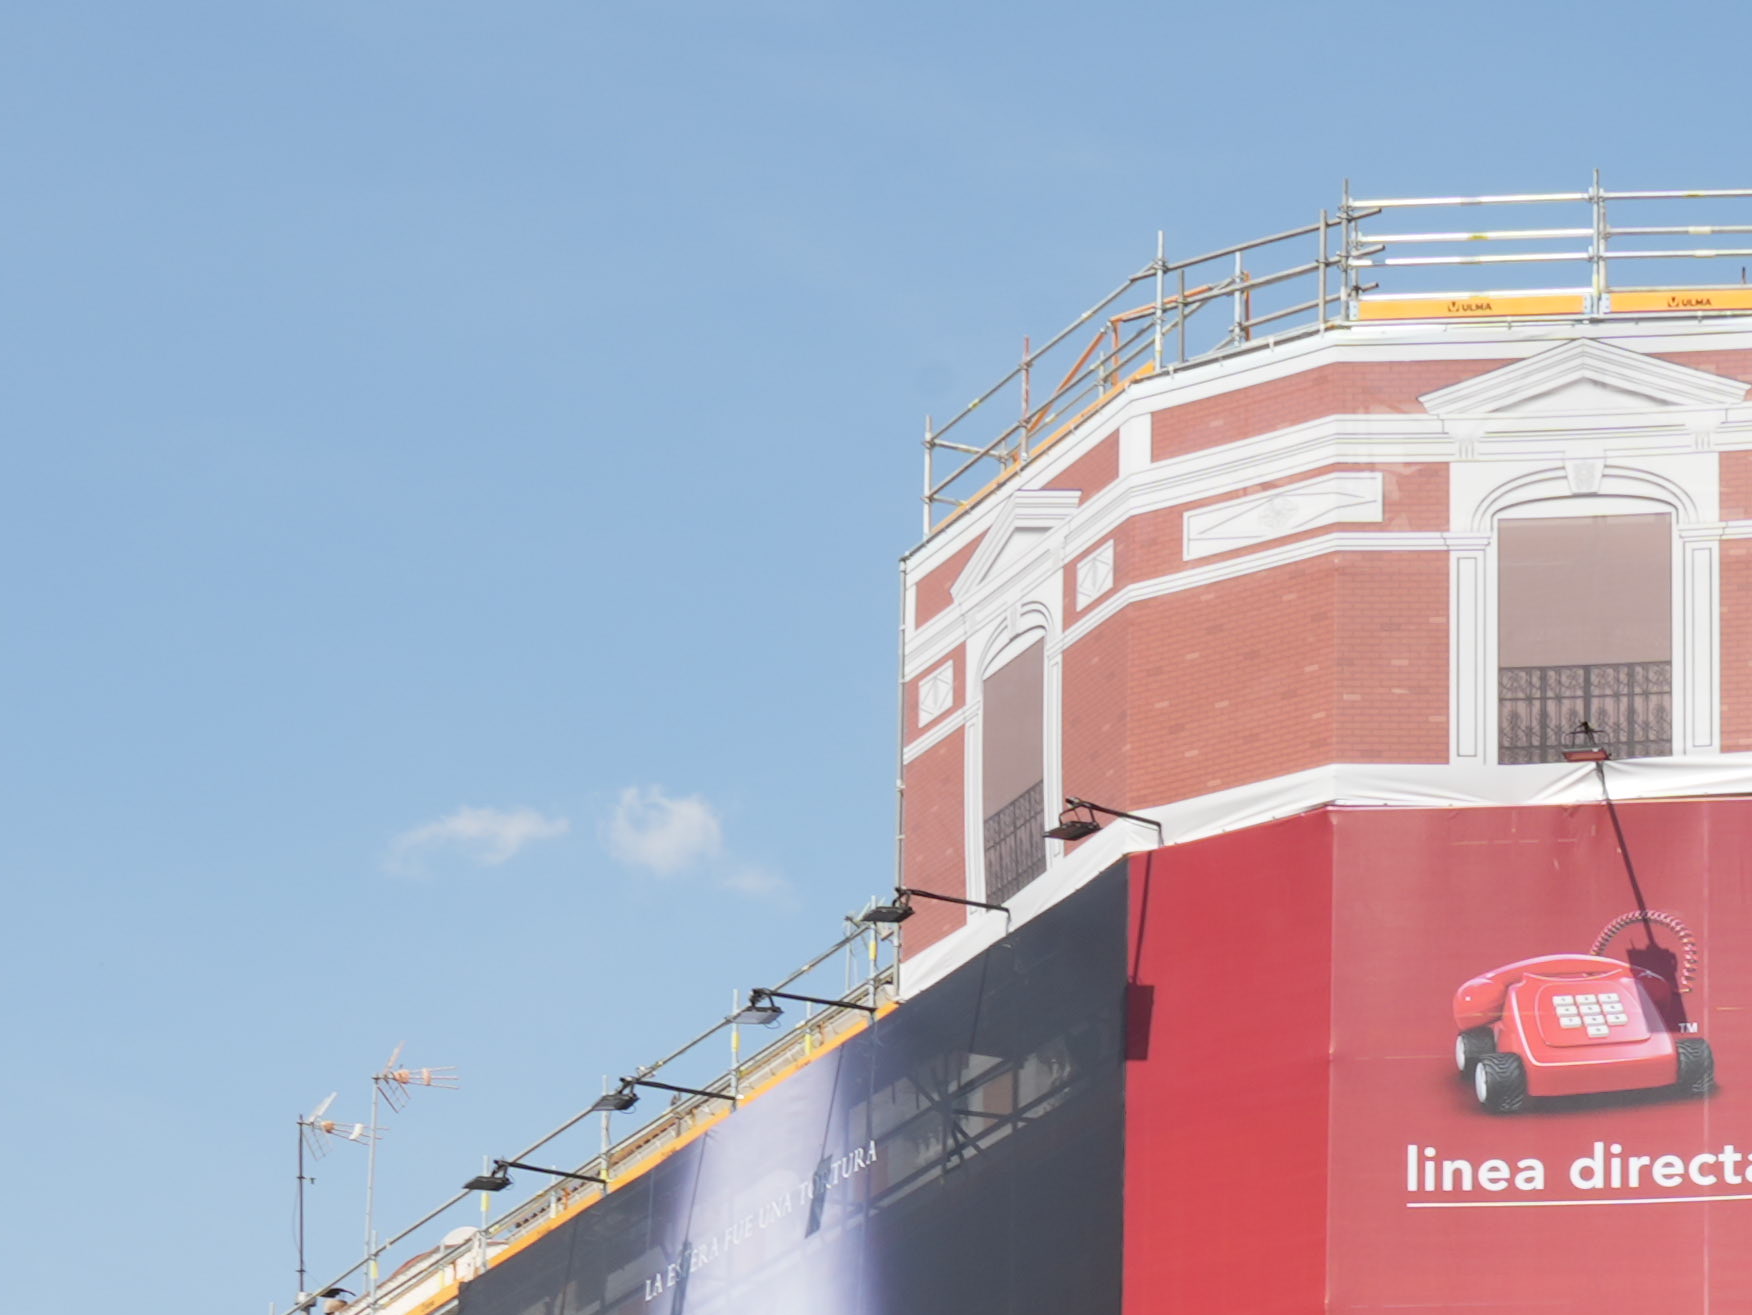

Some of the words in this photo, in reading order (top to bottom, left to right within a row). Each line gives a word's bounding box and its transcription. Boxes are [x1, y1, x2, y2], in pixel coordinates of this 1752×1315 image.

[1462, 303, 1492, 312] ULMA
[1682, 297, 1712, 307] ULMA
[1407, 1144, 1545, 1193] linea
[645, 1272, 662, 1301] LA
[723, 1214, 754, 1250] FUE
[758, 1190, 793, 1229] UNA
